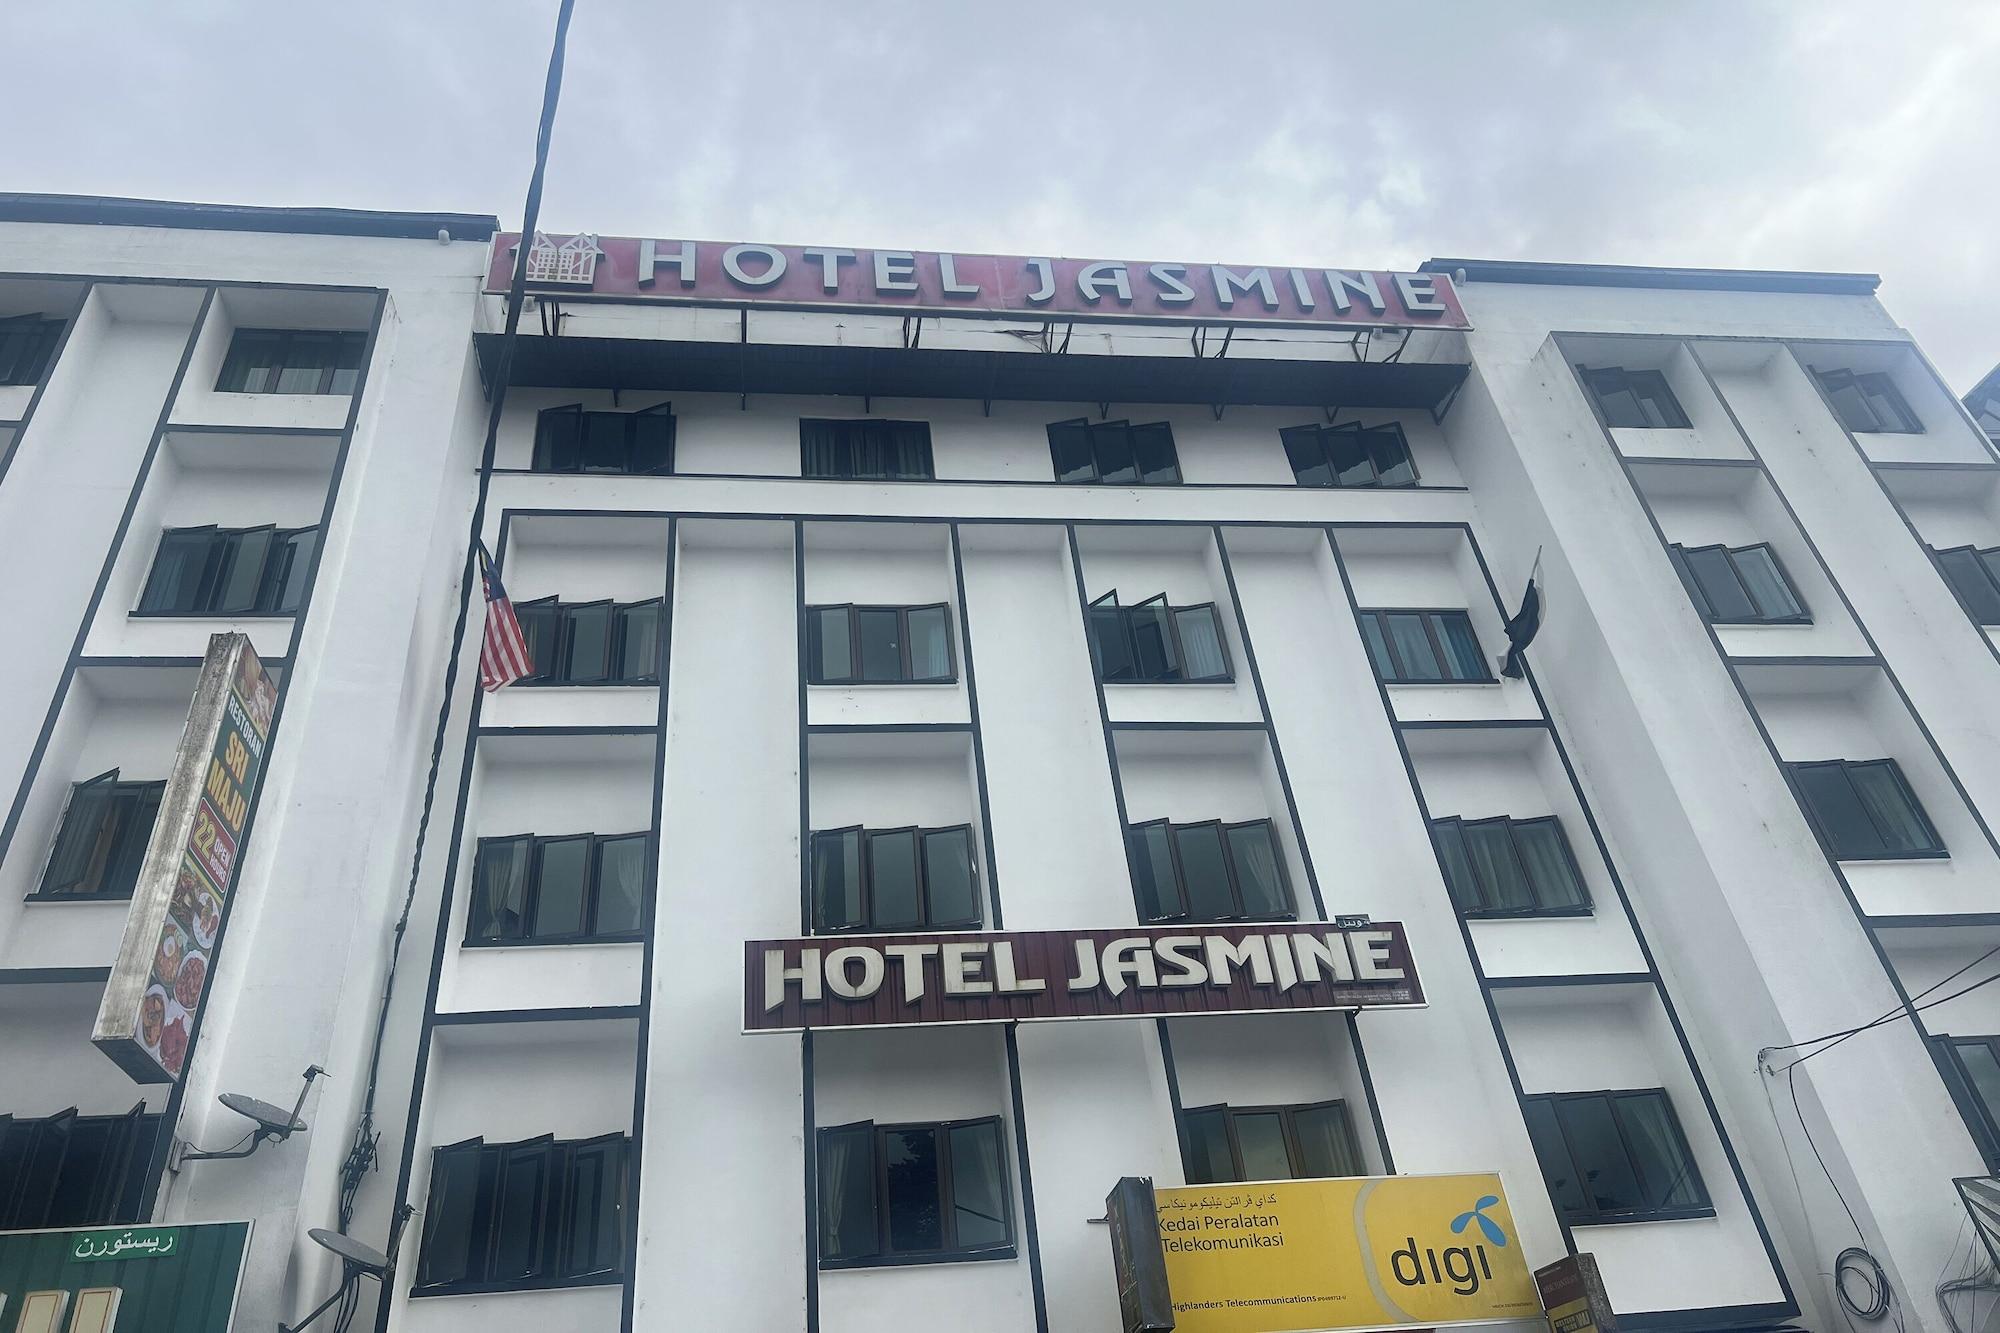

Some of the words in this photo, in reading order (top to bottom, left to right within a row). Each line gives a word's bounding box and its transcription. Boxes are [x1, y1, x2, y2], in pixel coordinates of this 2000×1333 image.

[638, 239, 980, 297] HOTEL
[1025, 257, 1446, 317] JASMINE
[228, 694, 262, 759] RESTORAN
[225, 730, 249, 784] SRI
[207, 757, 246, 832] MAJU
[193, 809, 217, 861] 22
[213, 837, 231, 870] OPEN
[208, 855, 228, 884] HOURS
[764, 940, 1048, 1014] HOTEL
[1067, 929, 1407, 999] JASMINE
[75, 1231, 173, 1258] ريستورن
[1162, 1232, 1285, 1254] Telekomunikasi
[1203, 1213, 1280, 1231] Peralatan
[1390, 1237, 1494, 1295] digi
[1224, 1294, 1318, 1309] Telecommunications
